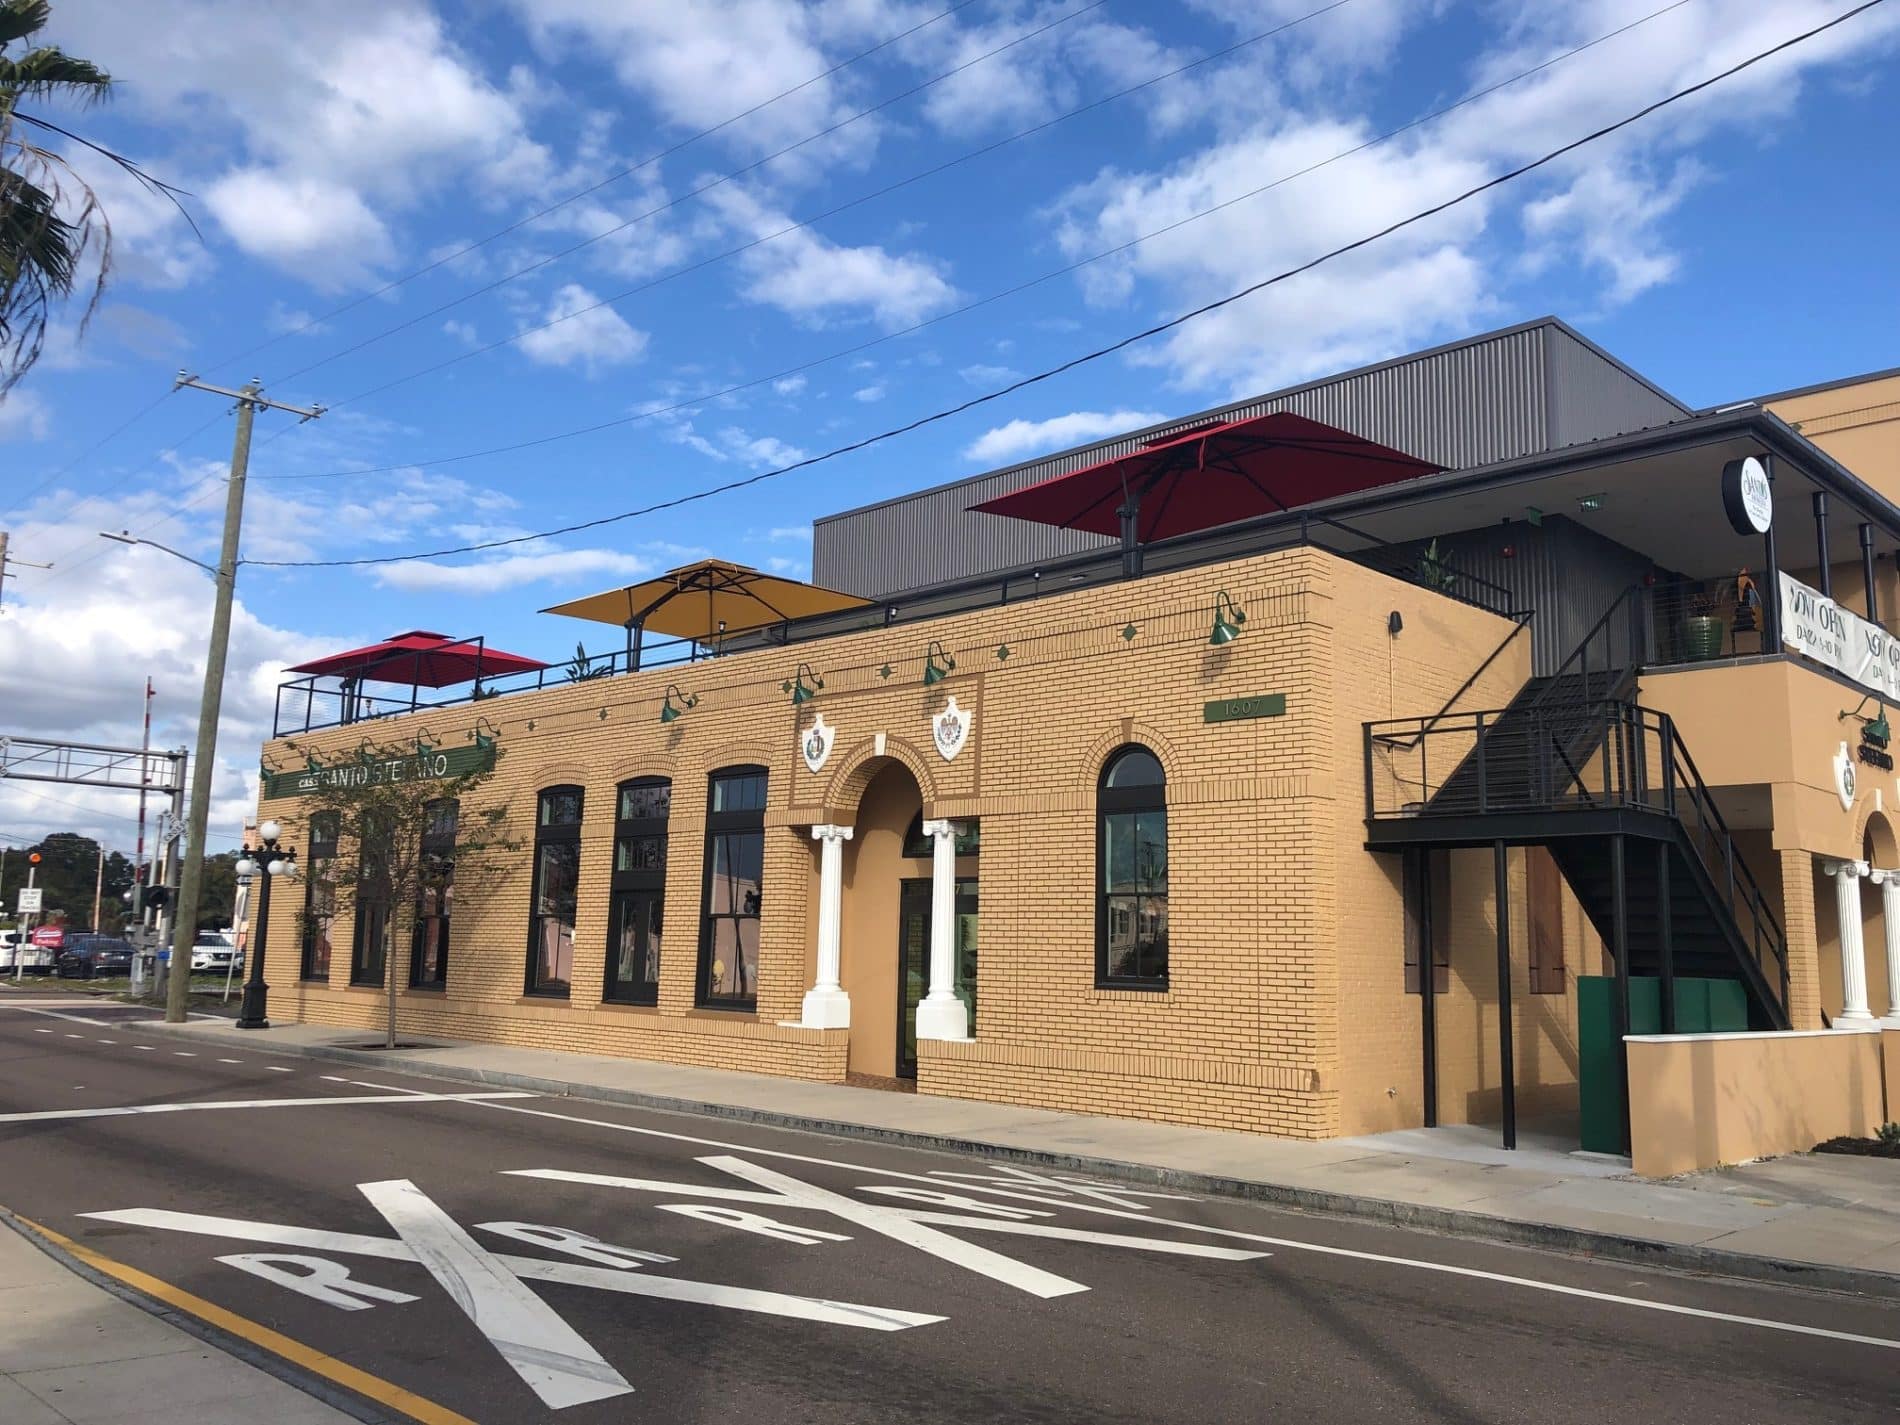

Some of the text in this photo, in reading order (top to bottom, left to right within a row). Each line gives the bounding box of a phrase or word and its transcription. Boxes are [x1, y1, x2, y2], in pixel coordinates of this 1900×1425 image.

[1224, 699, 1262, 716] 1607
[320, 765, 368, 787] SANTO
[371, 754, 447, 784] STEANO
[214, 1253, 421, 1311] R
[473, 1221, 680, 1268] R
